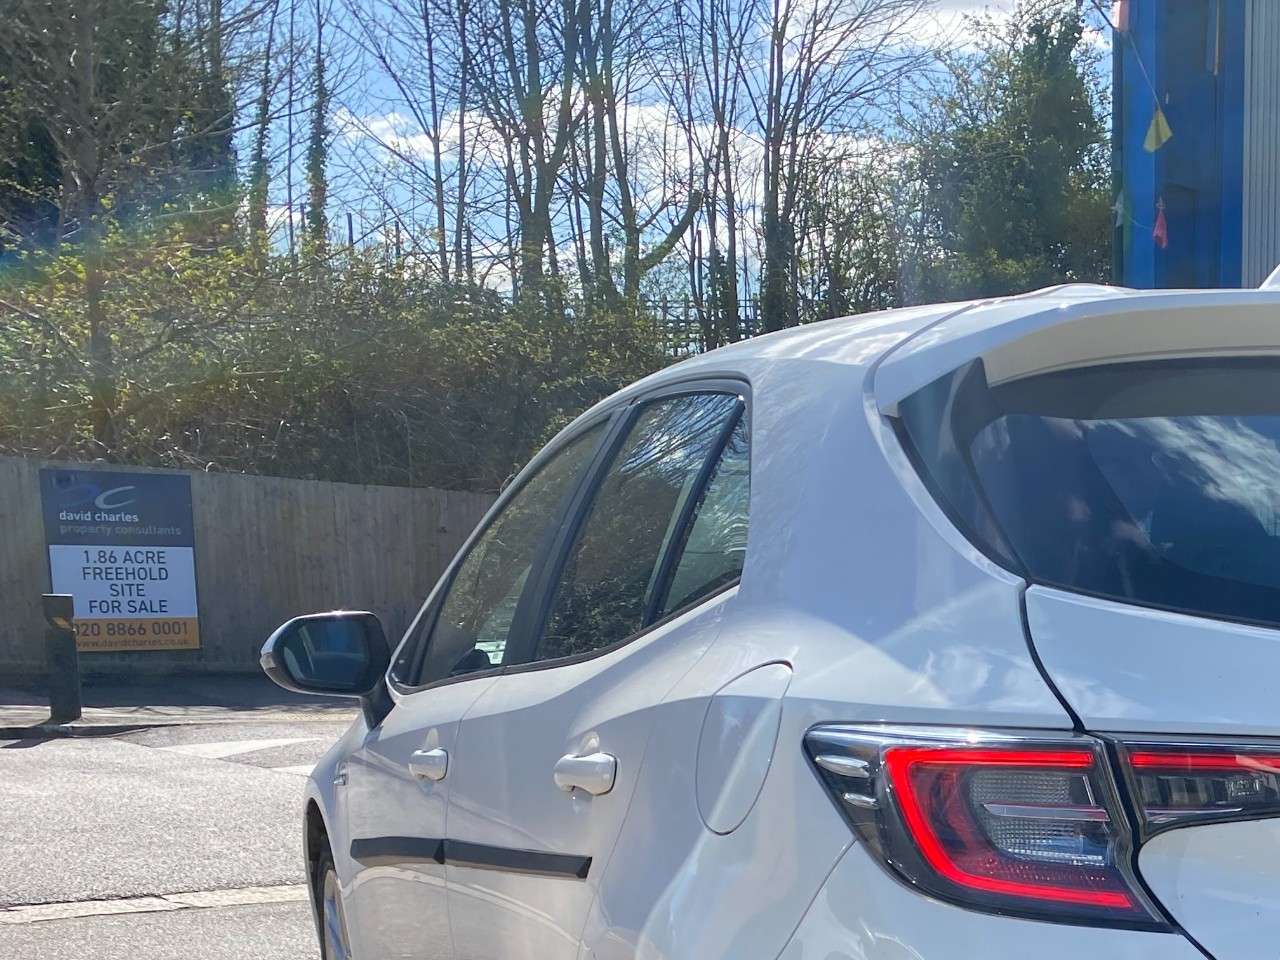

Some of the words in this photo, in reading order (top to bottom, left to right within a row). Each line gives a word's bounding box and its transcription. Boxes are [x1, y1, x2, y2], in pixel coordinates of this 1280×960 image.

[59, 510, 92, 521] david
[94, 511, 139, 522] charles
[60, 524, 112, 536] property
[83, 550, 118, 564] 1.86
[122, 550, 167, 565] ACRE
[82, 567, 169, 581] FREEHOLD
[109, 583, 146, 597] SITE
[88, 600, 122, 614] FOR
[127, 600, 168, 614] SALE
[106, 622, 147, 637] 8866
[151, 621, 188, 636] 0001
